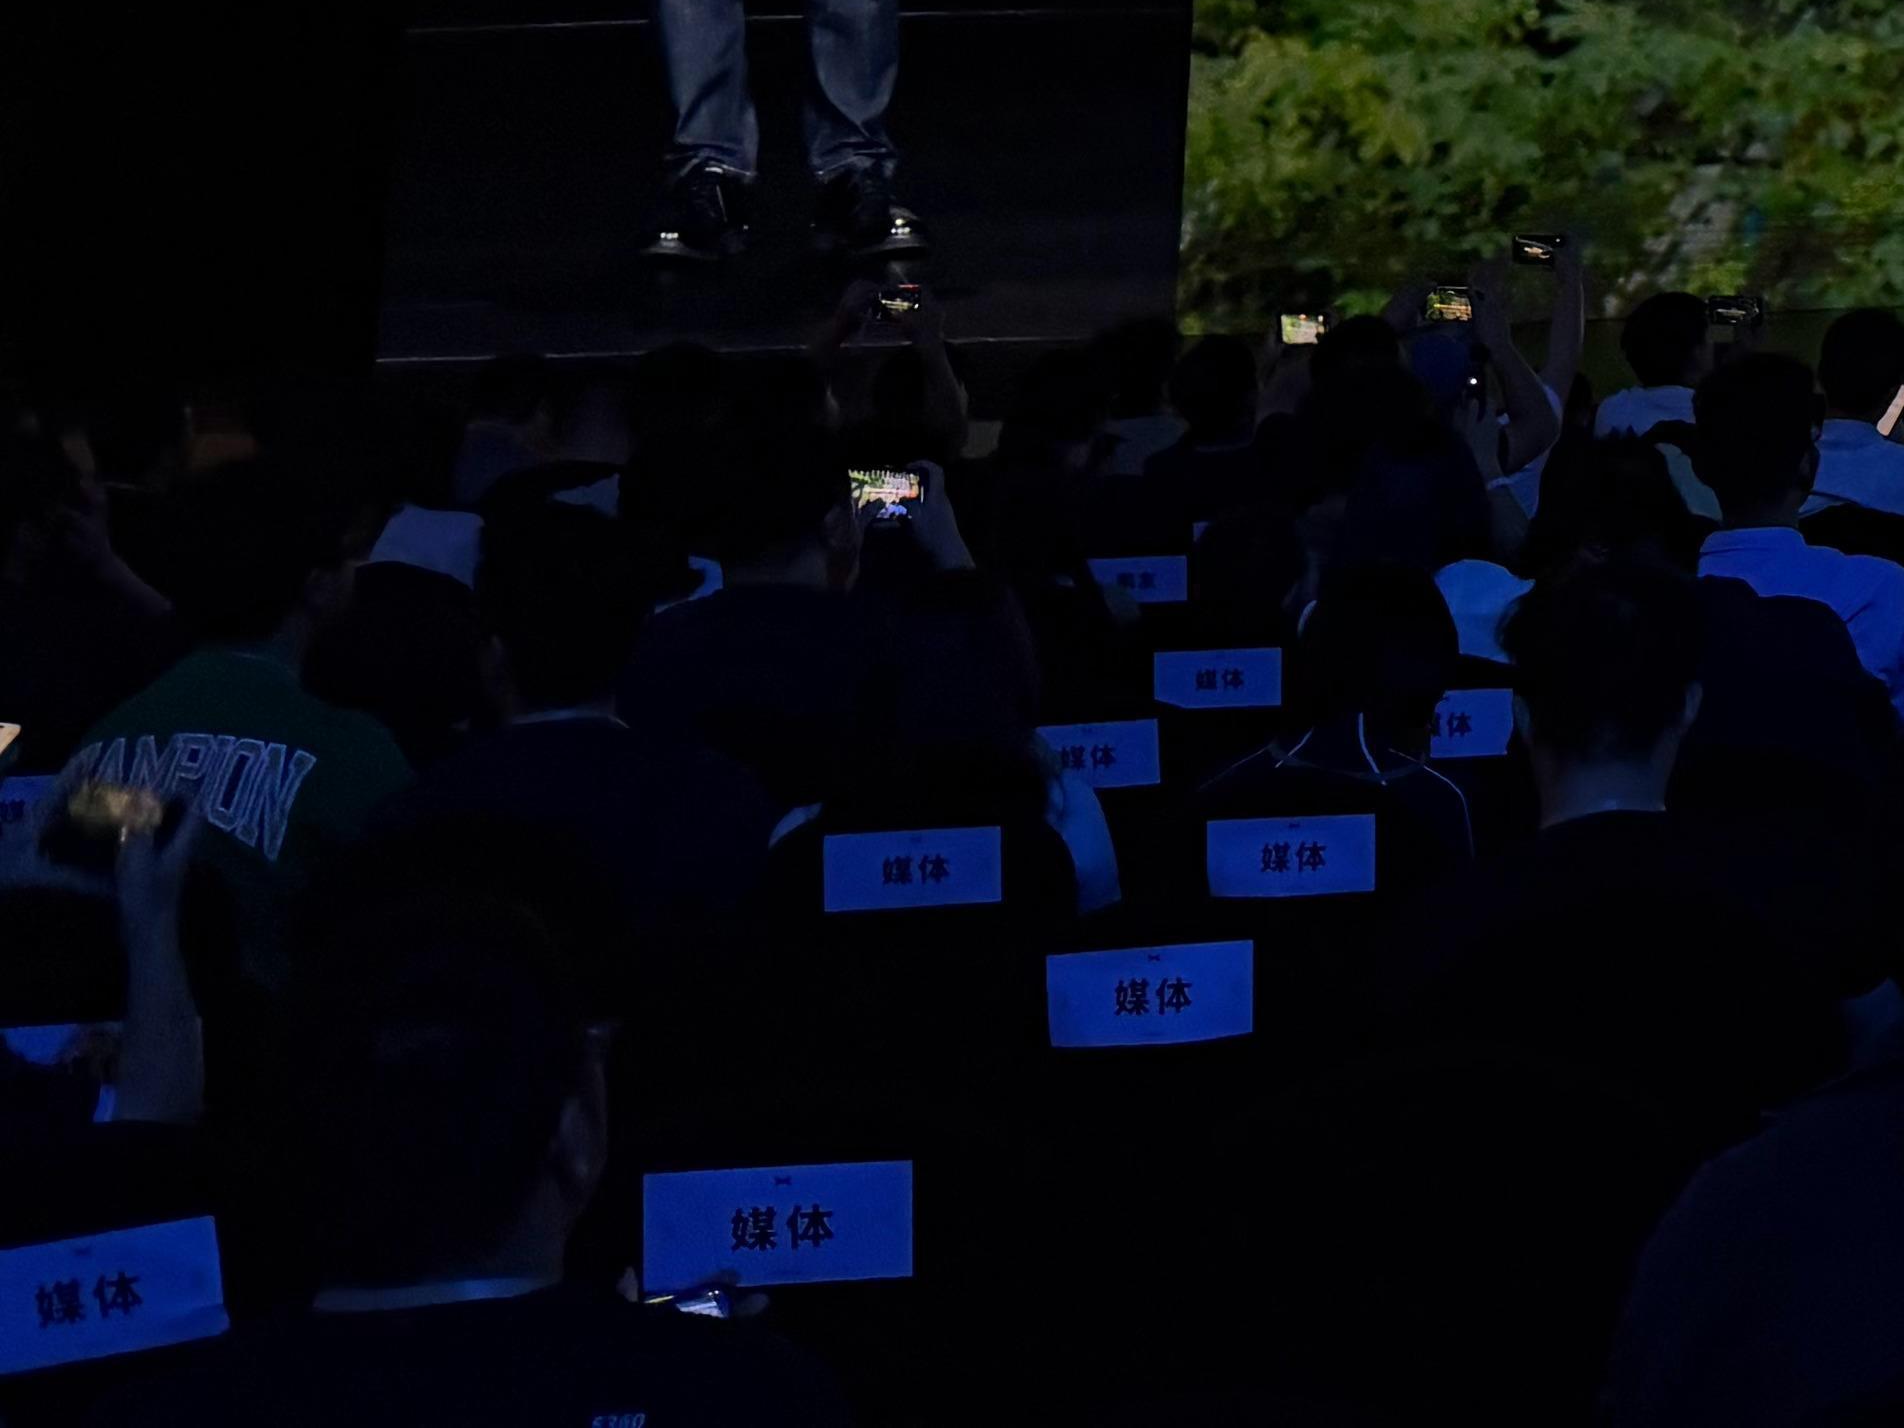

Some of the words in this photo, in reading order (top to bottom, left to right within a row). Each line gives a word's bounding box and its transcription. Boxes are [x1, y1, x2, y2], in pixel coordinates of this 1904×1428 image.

[882, 854, 950, 886] 媒体
[1261, 841, 1327, 872] 媒体
[1114, 977, 1192, 1016] 媒体
[731, 1204, 834, 1252] 媒体
[35, 1271, 143, 1329] 媒体
